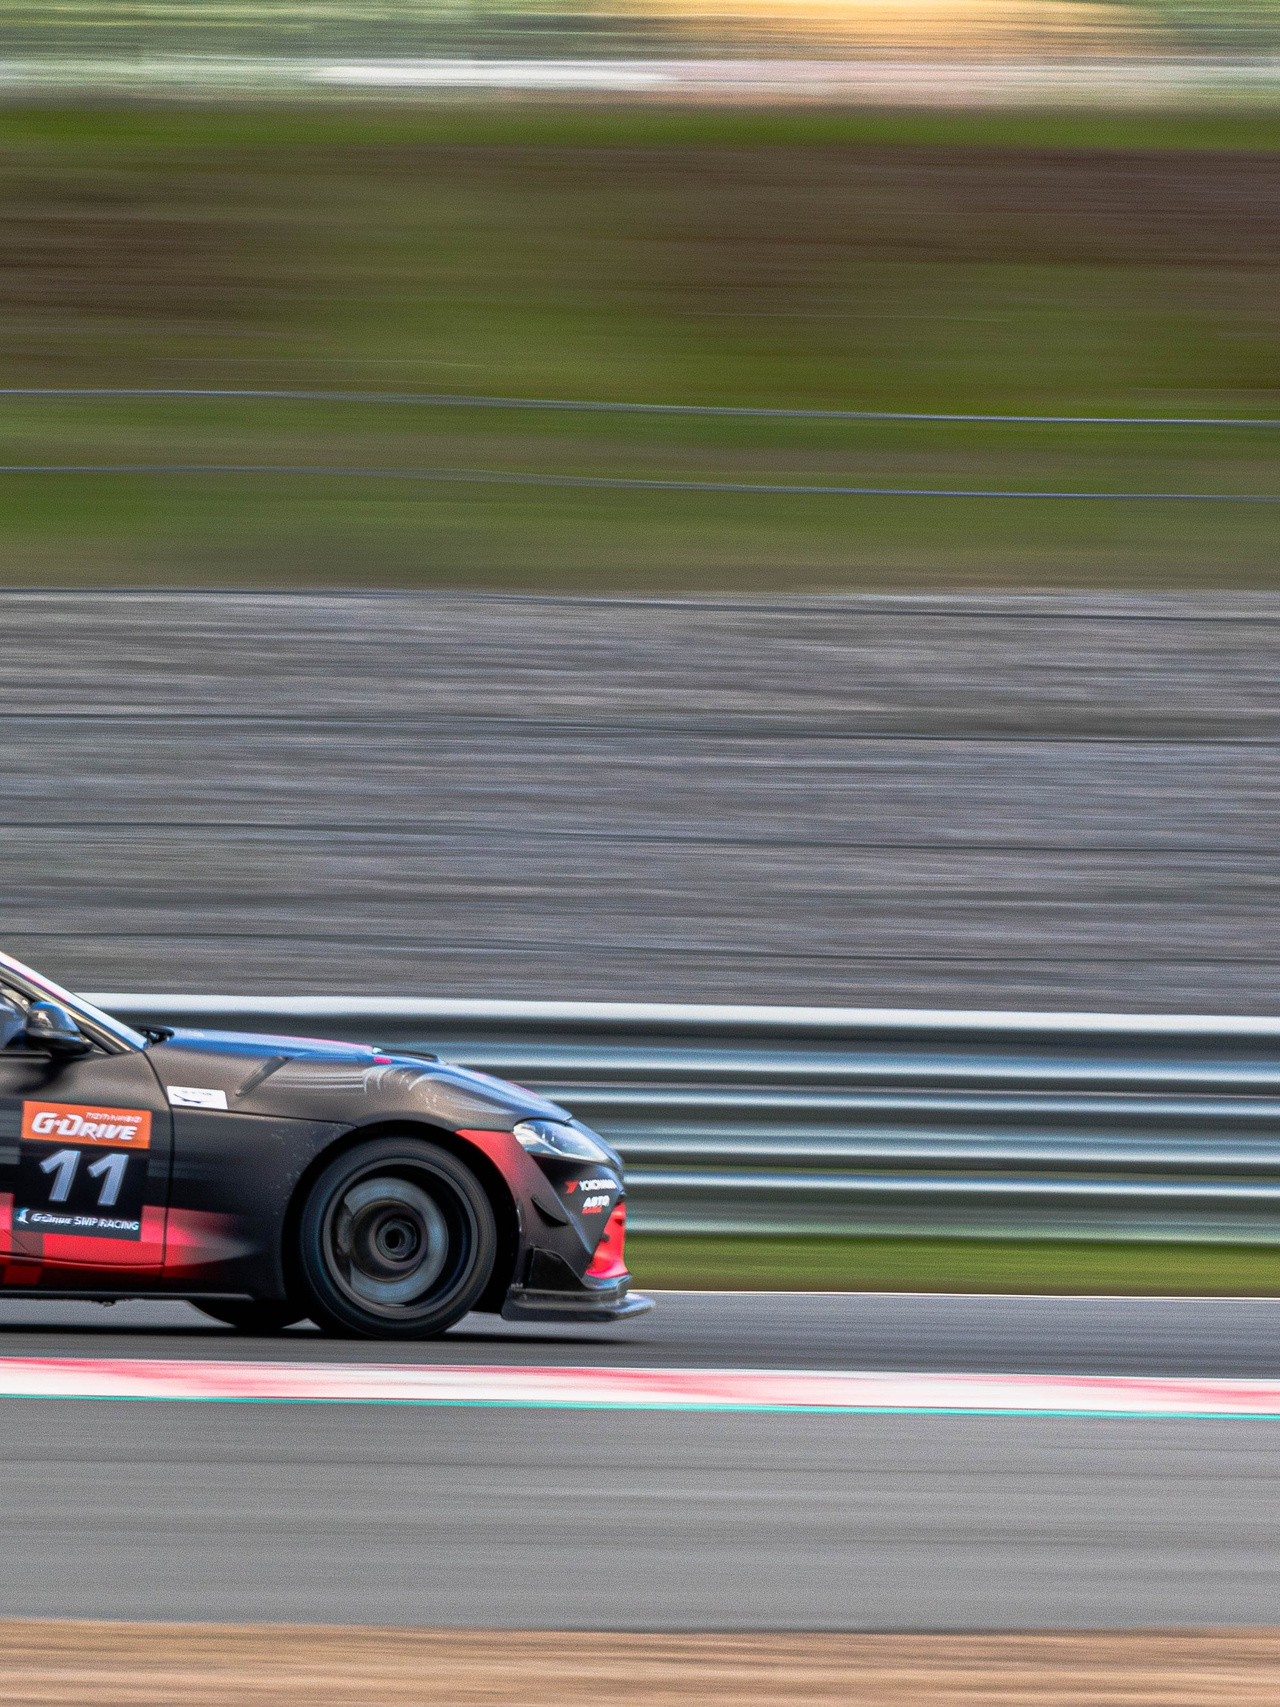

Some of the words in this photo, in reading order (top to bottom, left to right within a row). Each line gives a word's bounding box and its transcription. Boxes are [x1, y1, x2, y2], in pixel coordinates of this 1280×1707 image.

[39, 1149, 129, 1206] 11
[74, 1216, 98, 1227] SMP
[99, 1218, 140, 1231] RACING
